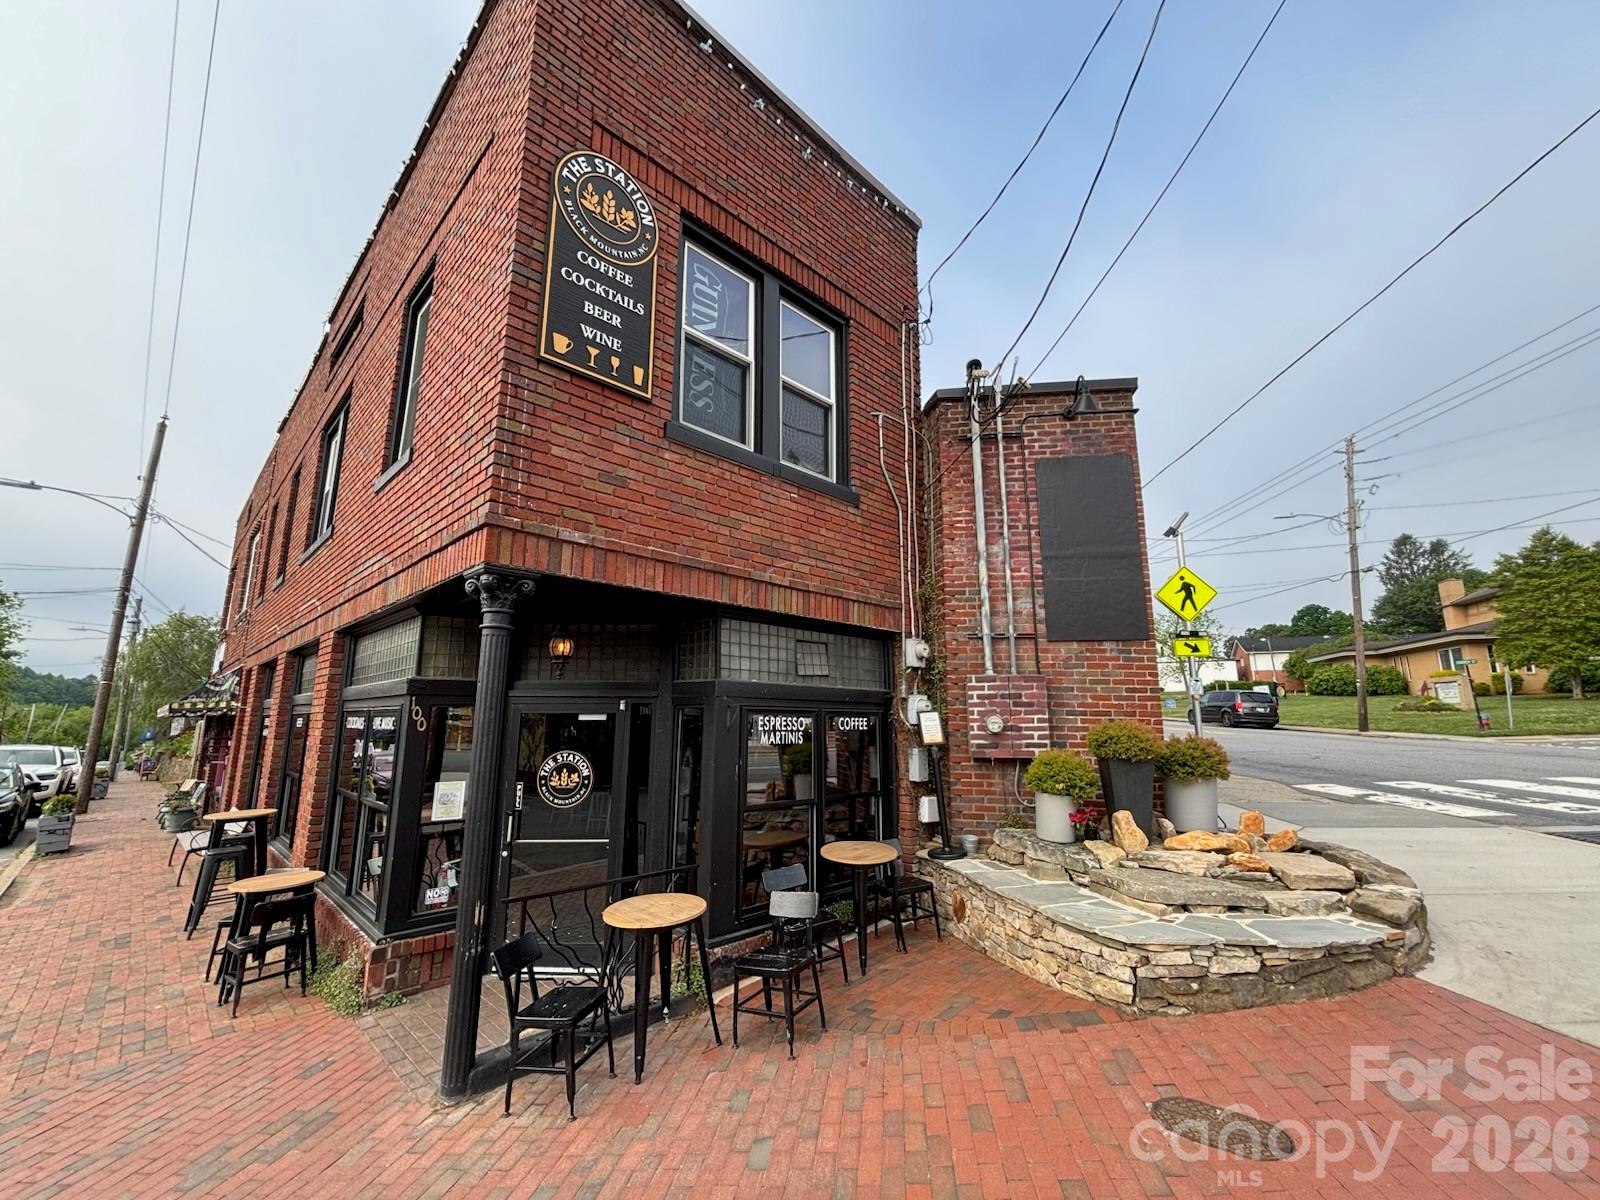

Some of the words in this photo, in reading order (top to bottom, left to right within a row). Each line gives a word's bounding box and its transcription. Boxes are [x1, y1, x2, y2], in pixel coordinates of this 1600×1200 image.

[562, 156, 592, 183] THE
[594, 158, 655, 228] STATION
[564, 199, 589, 235] BLACK
[576, 250, 634, 288] COFFEE
[561, 266, 645, 316] COCKTAILS
[583, 300, 623, 329] BEER
[579, 323, 623, 352] WINE
[411, 696, 427, 731] 100
[758, 716, 806, 731] ESPRESSO
[838, 717, 868, 730] COFFEE
[760, 731, 804, 745] MARTINIS
[540, 759, 556, 776] THE
[556, 753, 590, 776] STATION
